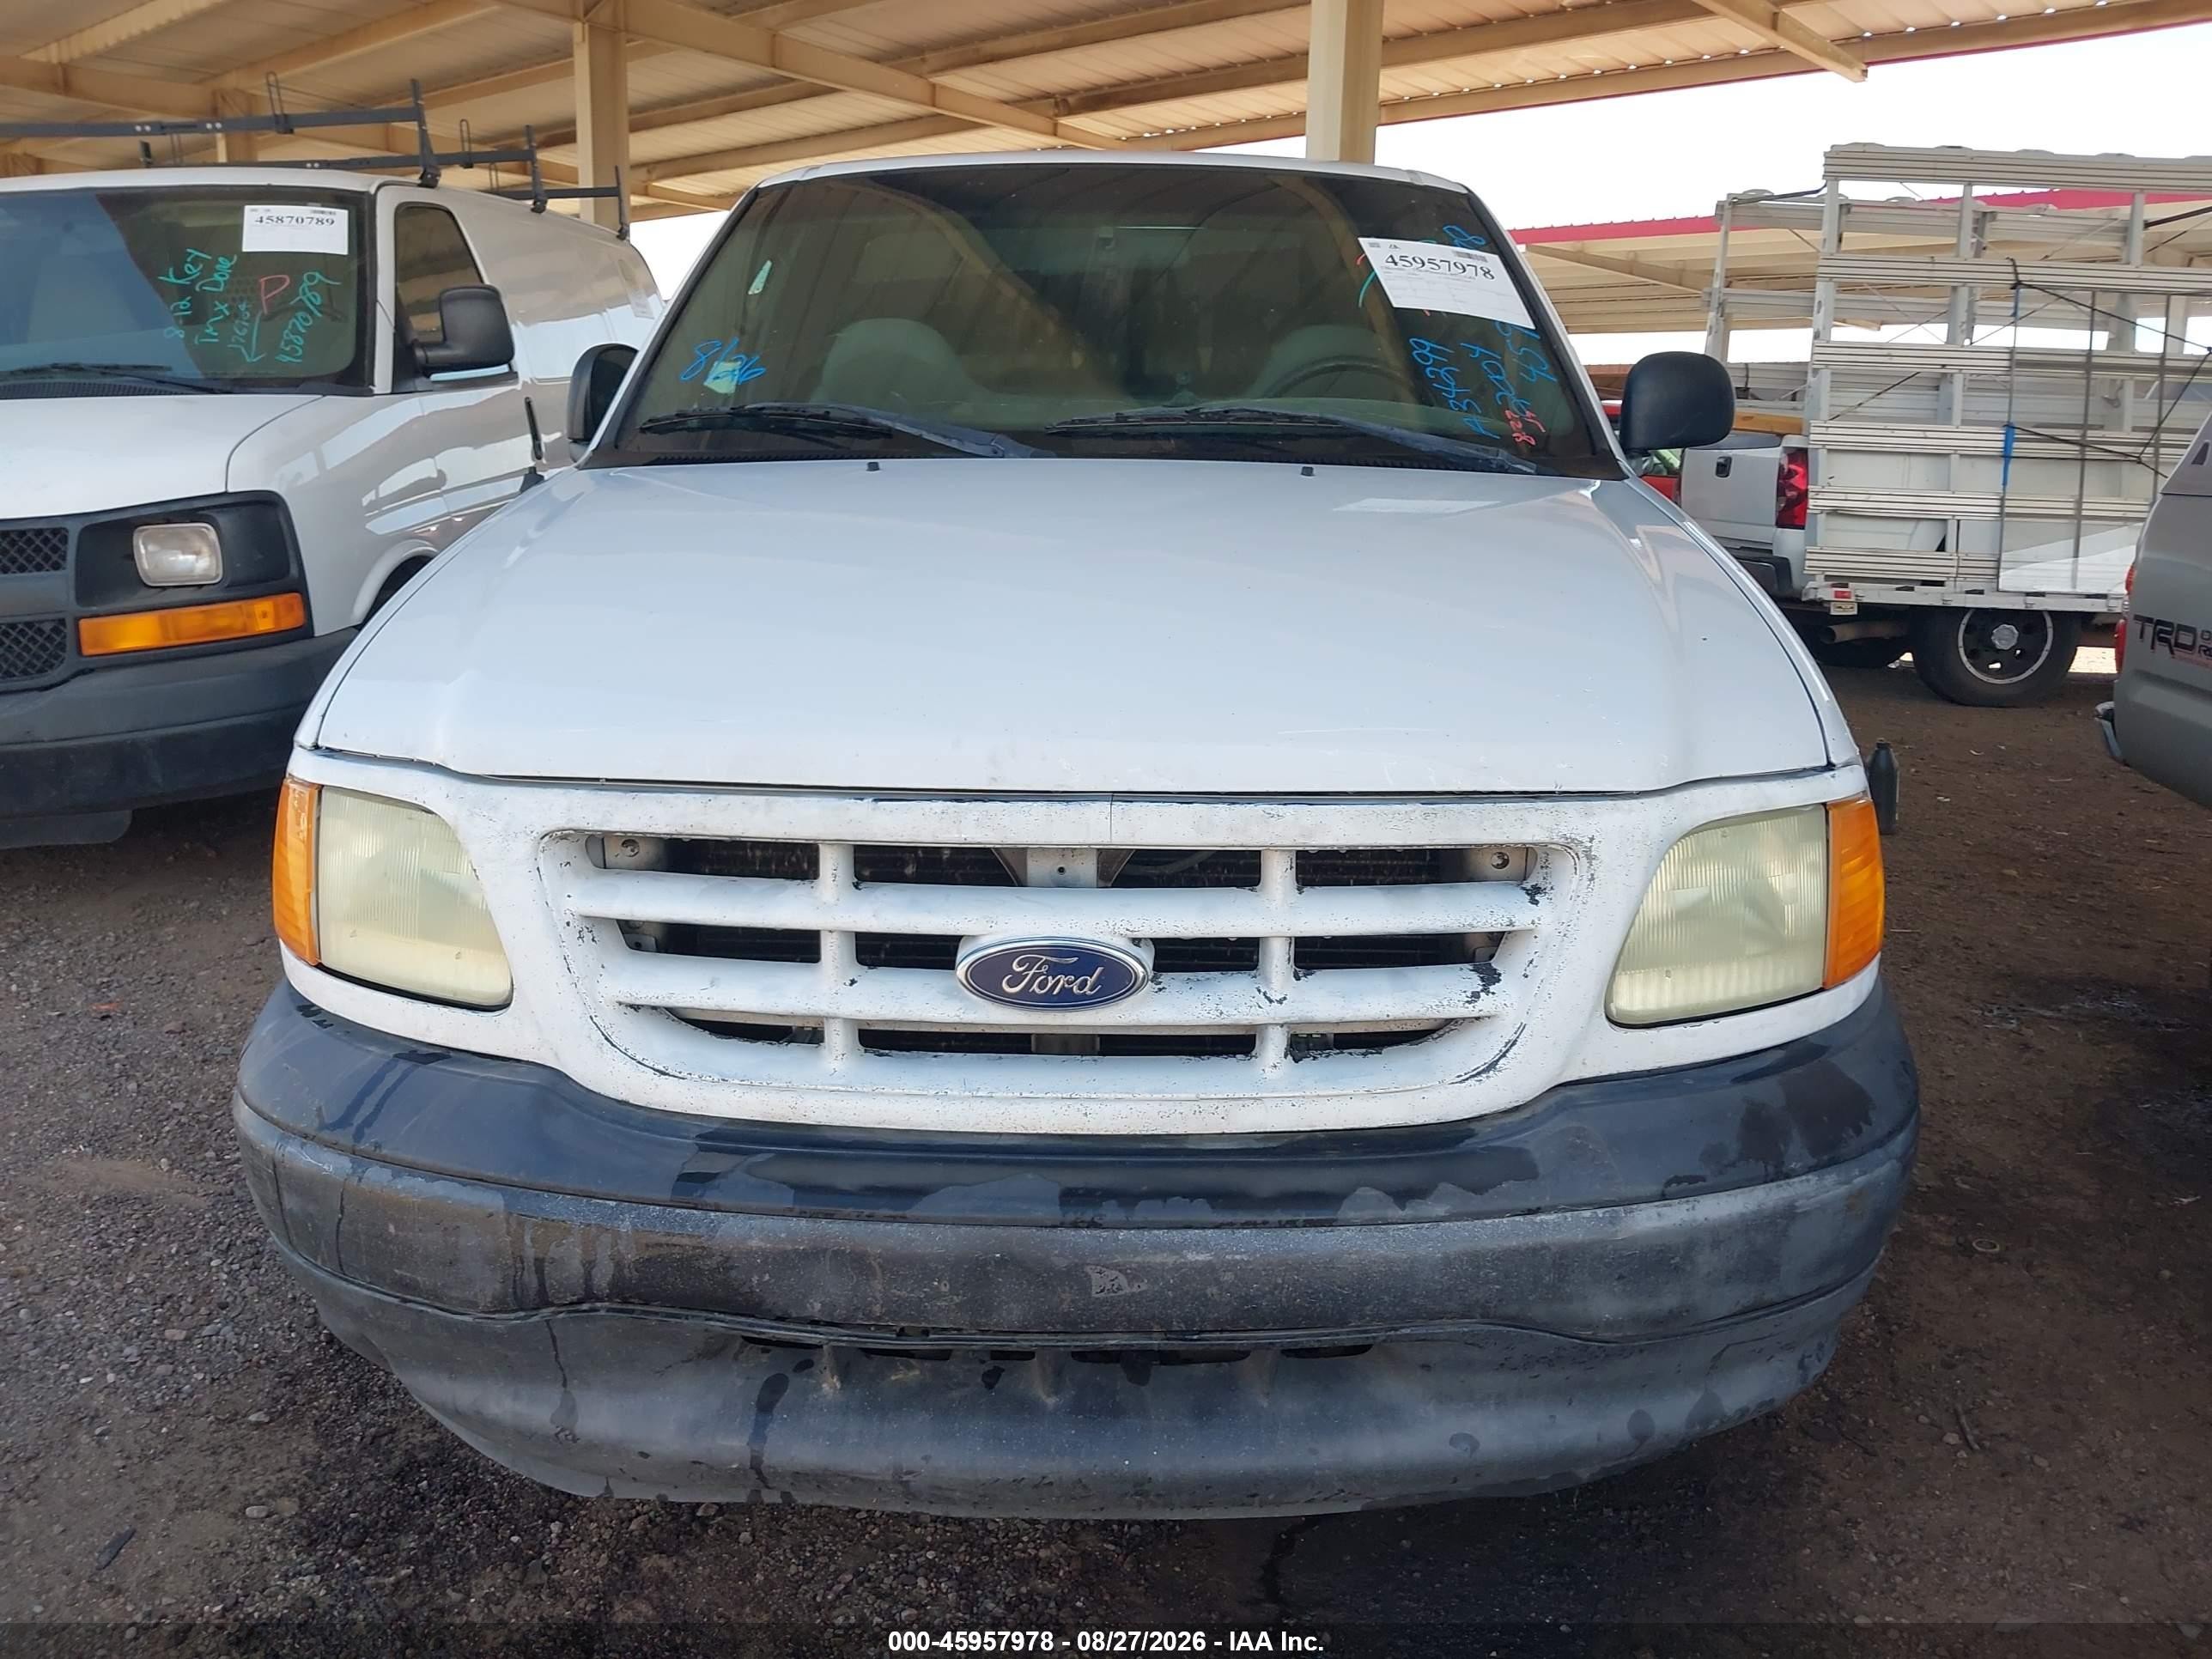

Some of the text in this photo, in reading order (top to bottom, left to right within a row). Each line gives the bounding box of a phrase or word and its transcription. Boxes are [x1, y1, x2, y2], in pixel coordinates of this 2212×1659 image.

[254, 216, 336, 227] 45870789
[157, 247, 213, 285] Key
[1384, 253, 1496, 281] 45957978
[2132, 613, 2197, 657] TRD
[1000, 953, 1105, 996] Ford
